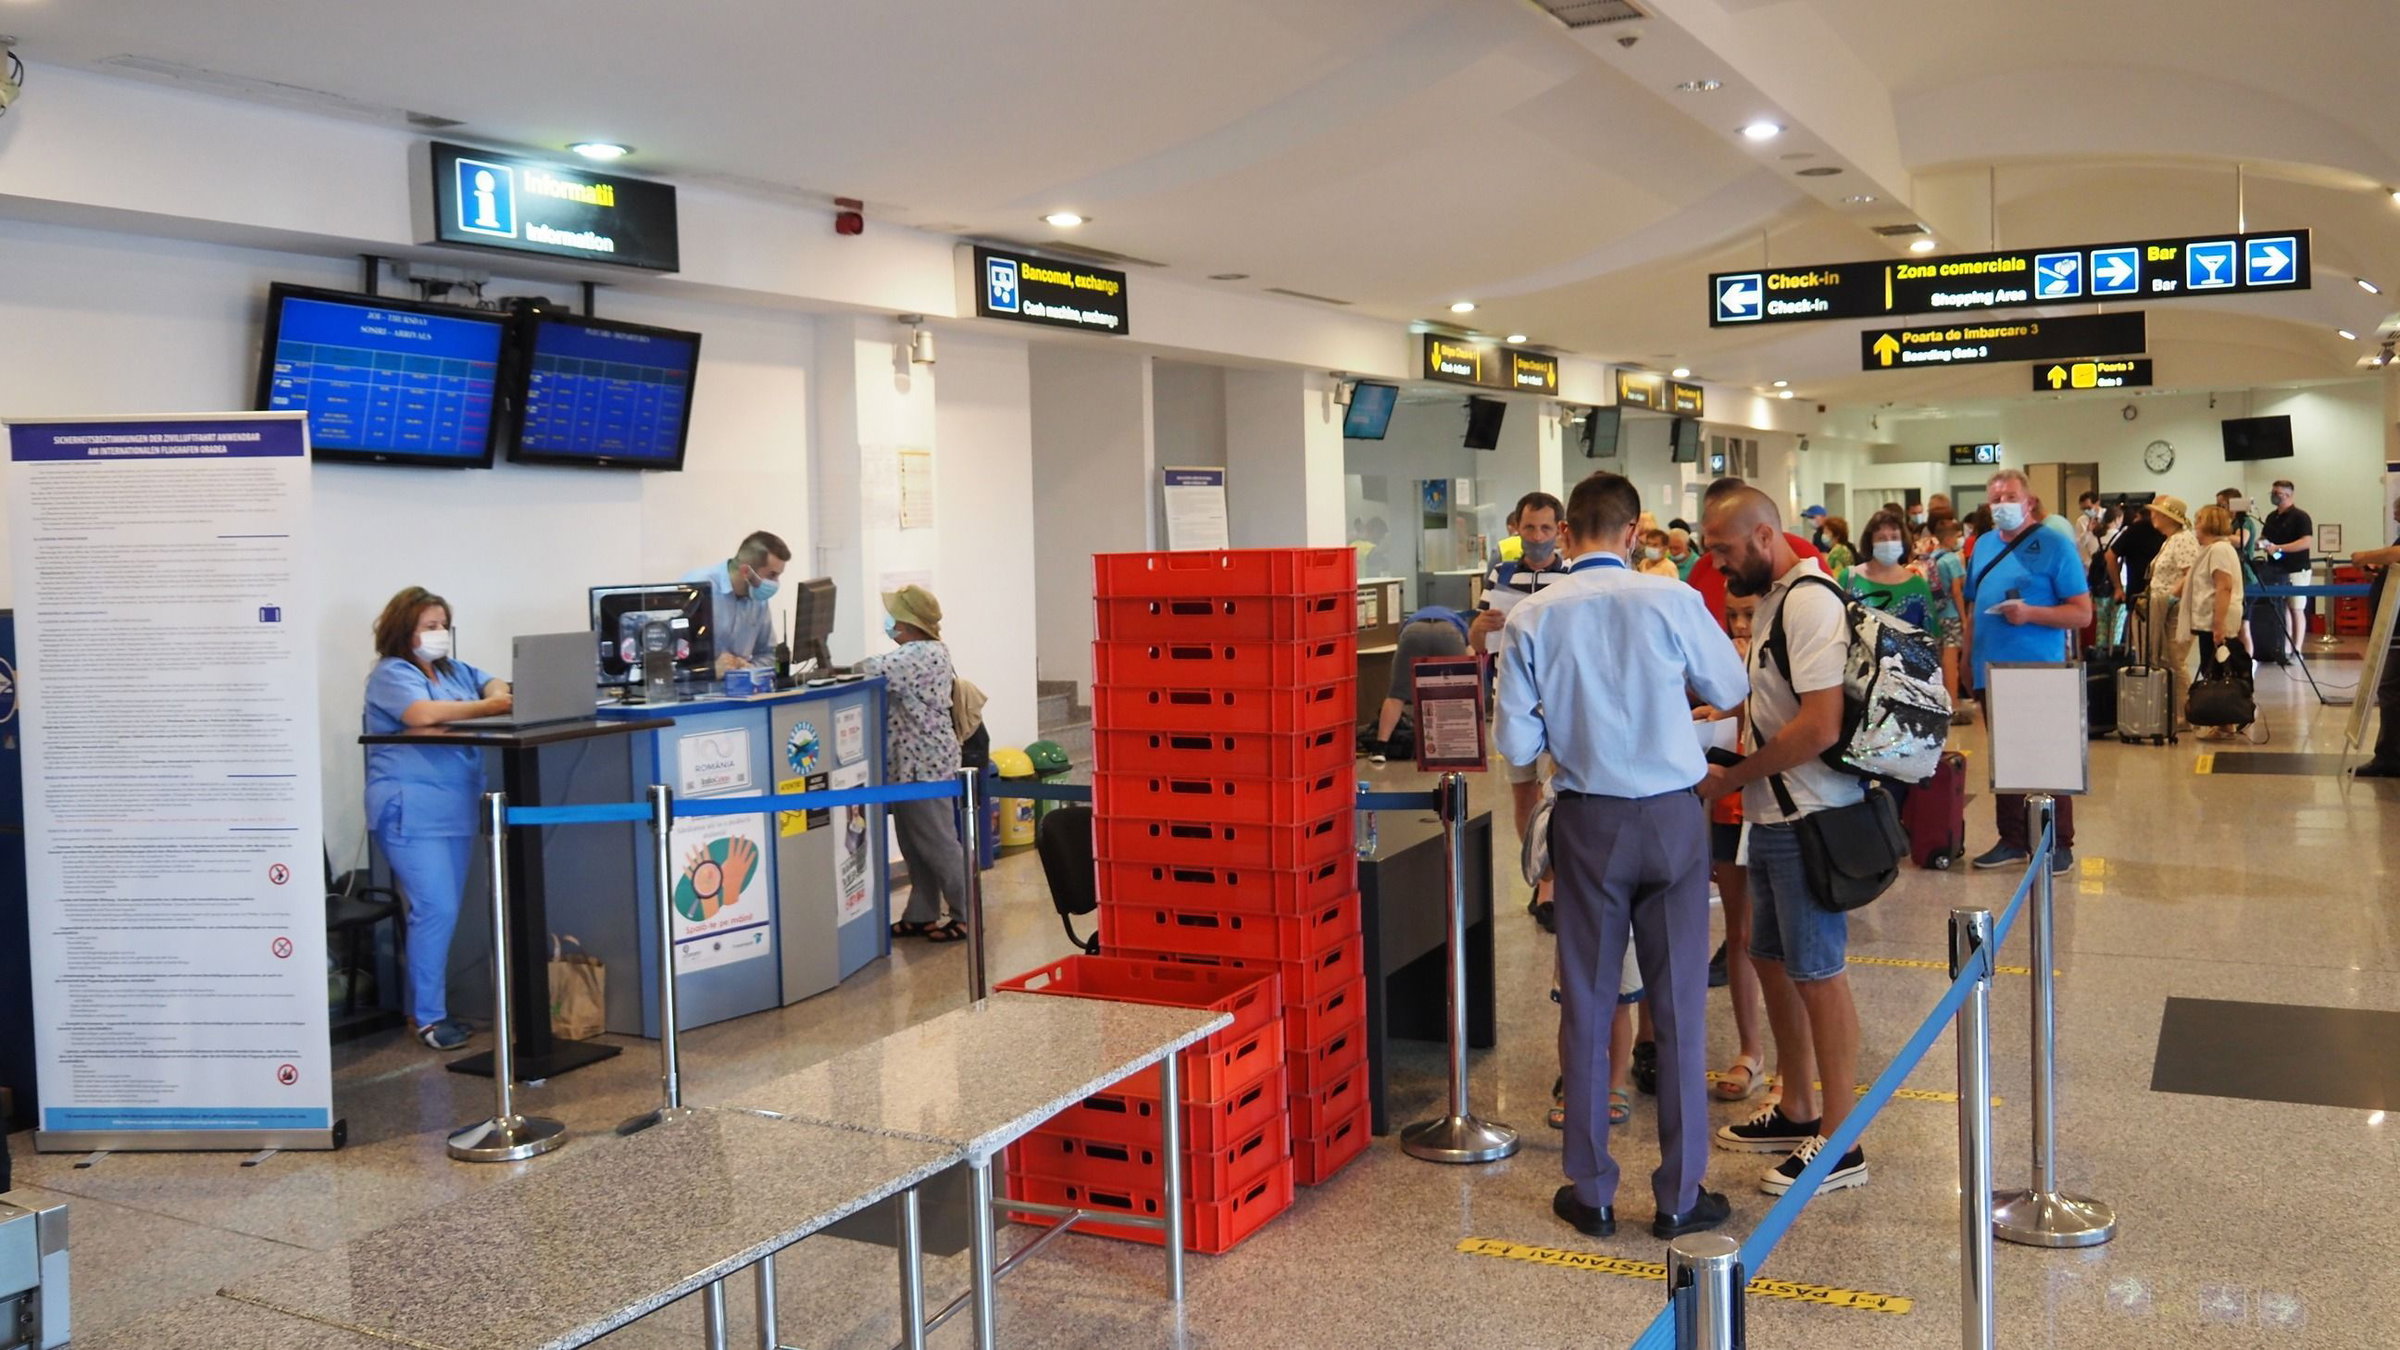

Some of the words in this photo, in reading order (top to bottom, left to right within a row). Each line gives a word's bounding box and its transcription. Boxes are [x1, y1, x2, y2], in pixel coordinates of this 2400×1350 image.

[525, 221, 615, 253] Information
[2147, 245, 2178, 262] Bar
[1896, 263, 1937, 280] Zona
[1939, 257, 2027, 277] comerciala
[1021, 262, 1075, 289] Bancomat,
[1074, 273, 1119, 296] exchange
[1767, 271, 1841, 290] Check-in
[2151, 278, 2178, 292] Bar
[1767, 297, 1829, 316] Check-in
[1930, 290, 1994, 308] Shopping
[1995, 288, 2028, 303] Area
[1022, 299, 1046, 318] Cash
[1081, 309, 1119, 329] exchange
[394, 328, 433, 340] ARRIVALS
[1902, 329, 1944, 344] Poarta
[1945, 328, 1962, 341] de
[2030, 323, 2039, 335] 3
[1902, 347, 1952, 363] Boarding
[1952, 346, 1978, 360] Gate
[1978, 345, 1988, 357] 3
[2097, 361, 2127, 373] Poarta
[2127, 361, 2135, 371] 3
[149, 434, 163, 444] DER
[160, 445, 199, 455] FLUGHAFEN
[200, 444, 228, 454] ORADEA
